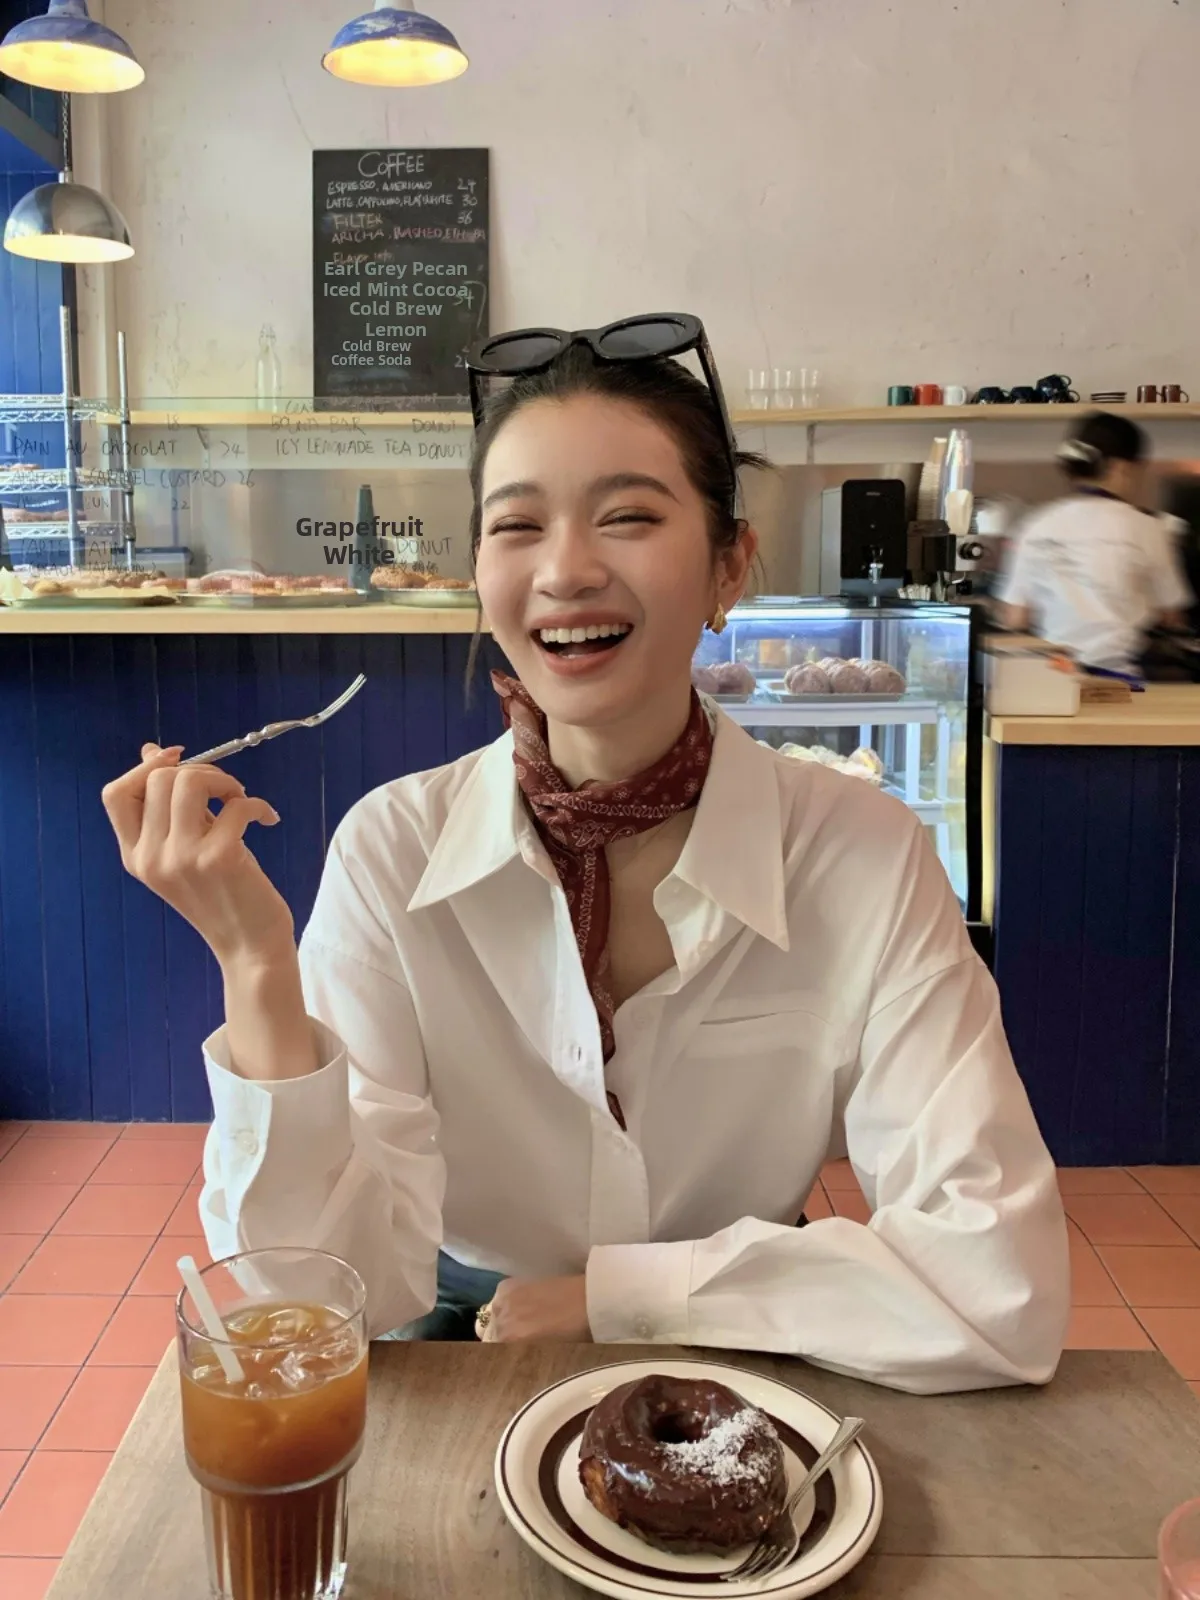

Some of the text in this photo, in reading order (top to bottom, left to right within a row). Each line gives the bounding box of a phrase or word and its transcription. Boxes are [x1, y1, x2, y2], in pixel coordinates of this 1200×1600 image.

[14, 436, 50, 456] PAIN
[276, 438, 300, 456] ICY
[384, 437, 411, 454] TEA
[418, 441, 466, 460] DONUT
[396, 536, 452, 556] DONUT
